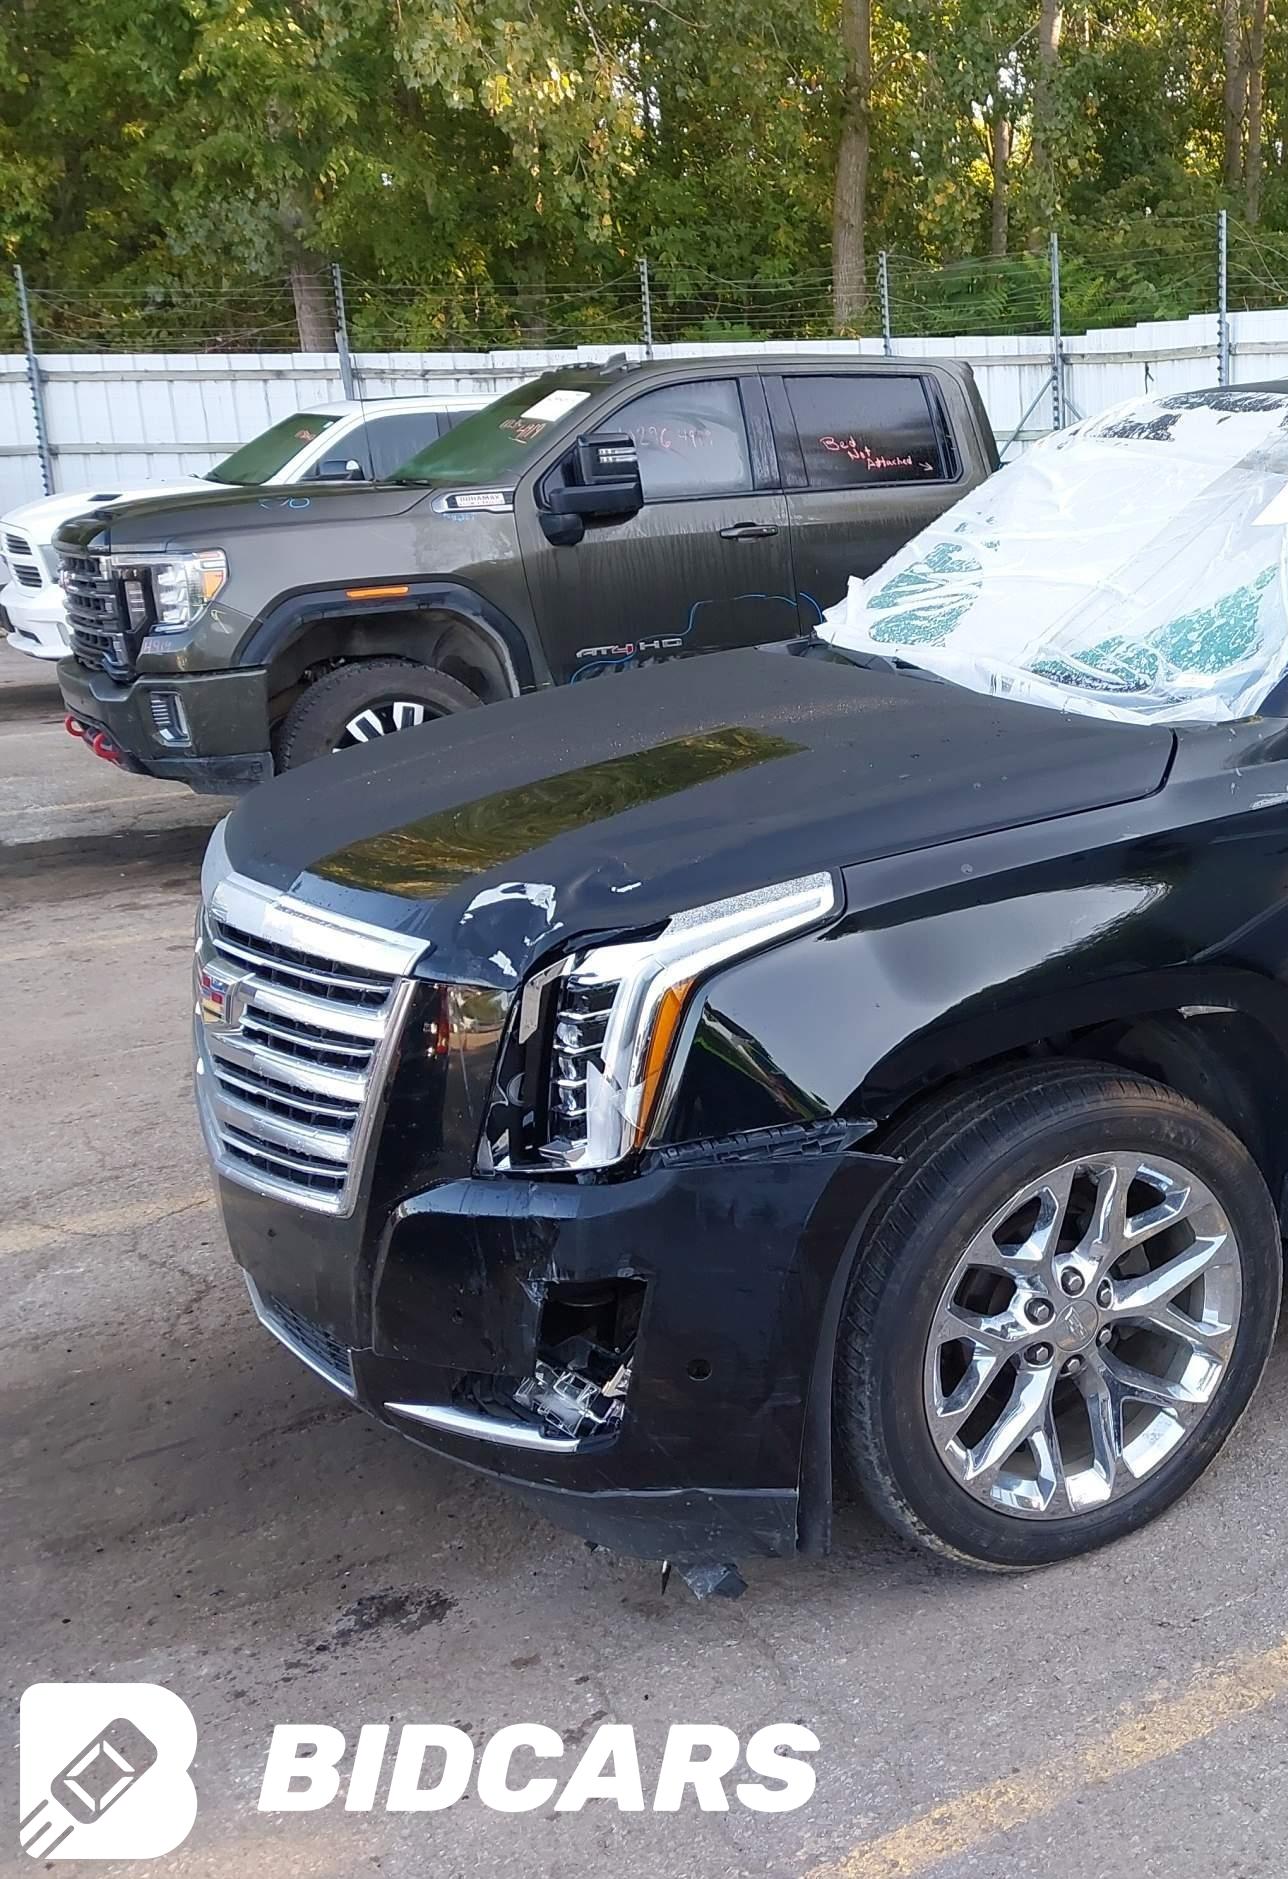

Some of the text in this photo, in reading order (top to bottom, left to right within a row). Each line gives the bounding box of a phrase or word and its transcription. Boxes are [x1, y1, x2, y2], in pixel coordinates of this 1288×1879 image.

[819, 435, 857, 452] Bed
[847, 445, 871, 461] Not
[867, 455, 913, 470] Attached
[576, 638, 682, 658] AT4 HD
